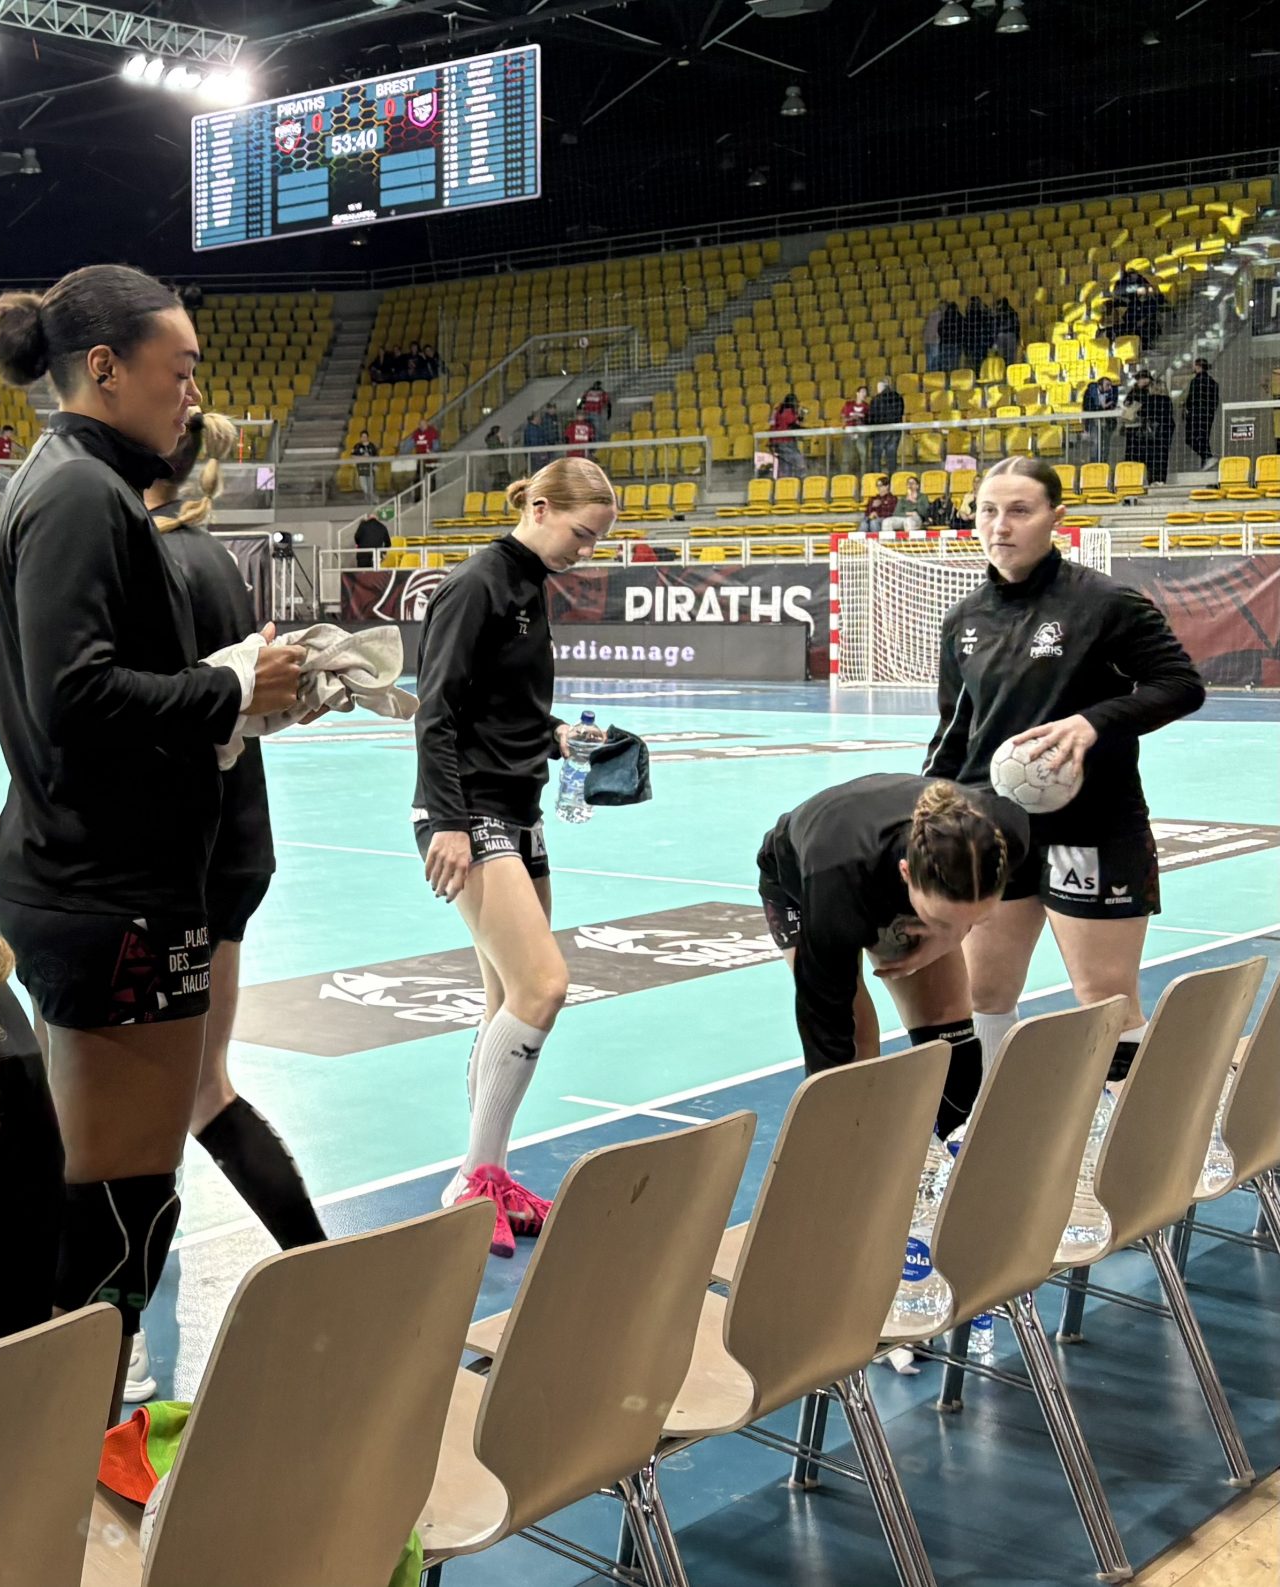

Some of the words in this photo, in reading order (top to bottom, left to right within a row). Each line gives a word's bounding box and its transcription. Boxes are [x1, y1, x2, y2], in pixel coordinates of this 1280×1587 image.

[376, 77, 416, 97] BREST
[277, 96, 325, 117] PIRATHS
[384, 98, 395, 117] 0
[312, 113, 323, 132] 0
[331, 129, 377, 155] 53:40
[625, 585, 815, 637] PIRATHS
[472, 829, 490, 842] DES
[1062, 867, 1095, 890] As
[169, 952, 190, 973] DES
[905, 1252, 931, 1267] ola
